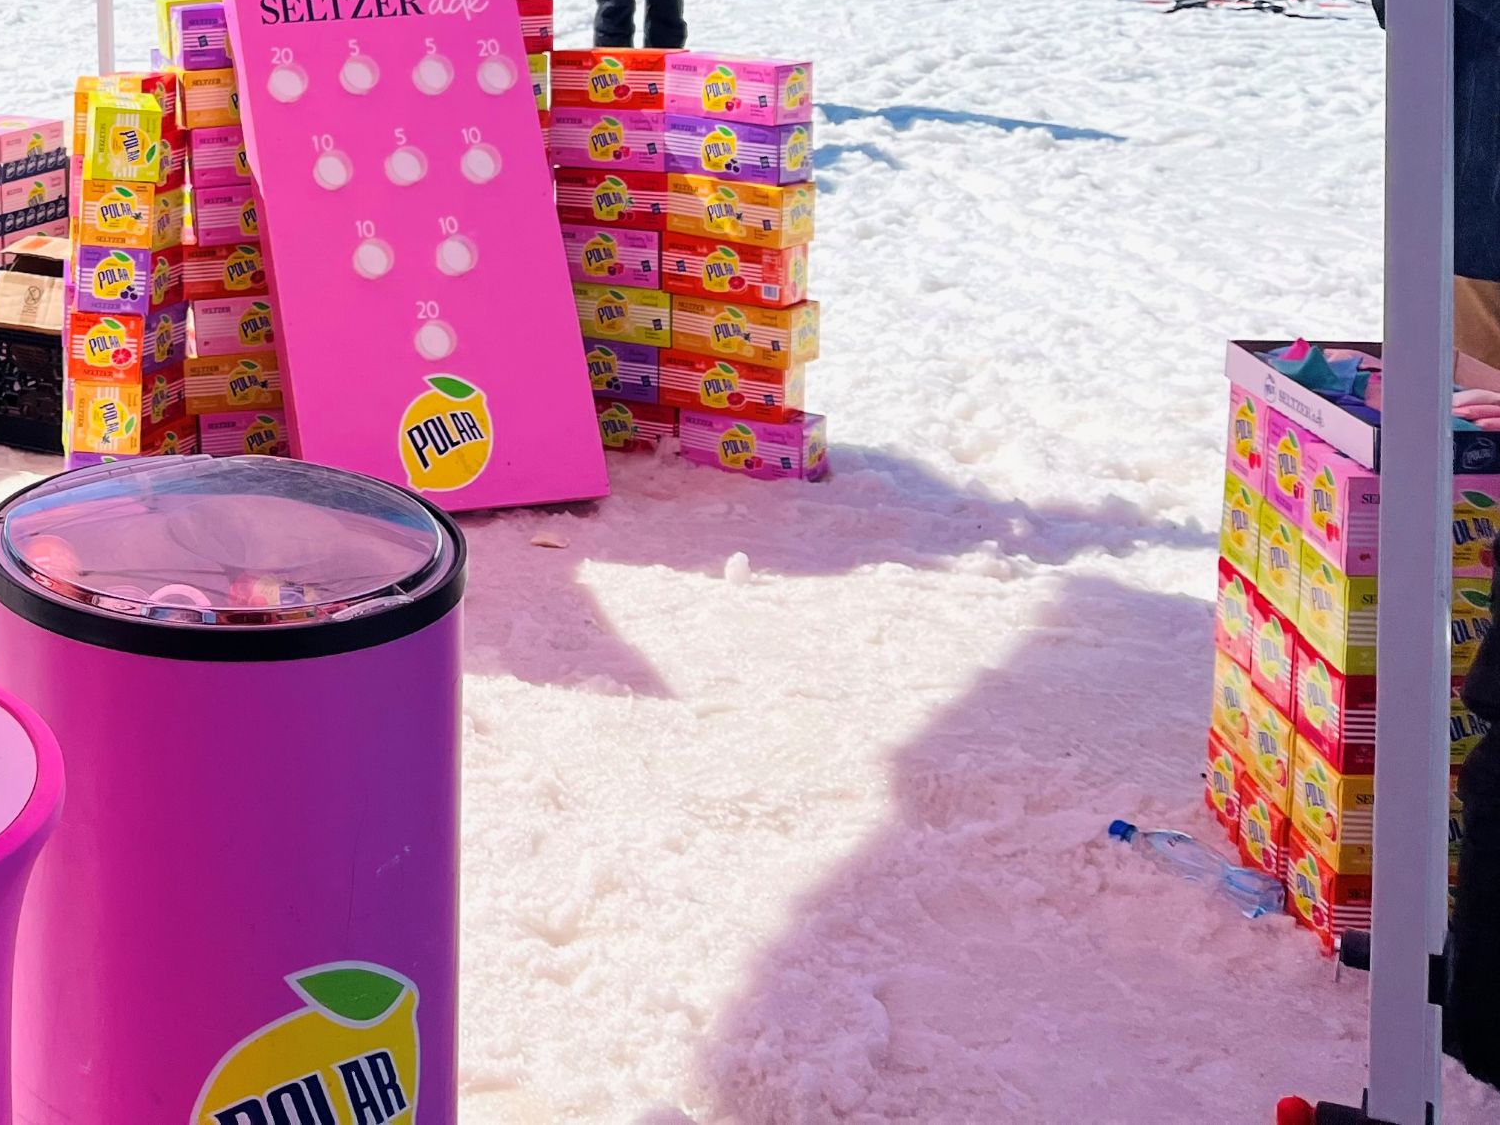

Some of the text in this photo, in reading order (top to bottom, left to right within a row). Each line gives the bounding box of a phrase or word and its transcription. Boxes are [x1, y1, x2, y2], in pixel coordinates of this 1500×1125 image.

[271, 38, 500, 64] 20 5 5 20
[591, 73, 621, 94] POLAR
[705, 82, 732, 102] POLAR
[119, 130, 141, 163] POLAR
[312, 126, 482, 152] 10 5 10
[591, 131, 620, 152] POLAR
[704, 143, 732, 162] POLAR
[100, 201, 133, 223] POLAR
[595, 192, 625, 212] POLAR
[707, 203, 736, 223] POLAR
[355, 216, 459, 238] 10 10
[585, 247, 614, 267] POLAR
[97, 269, 130, 290] POLAR
[227, 259, 258, 282] POLAR
[705, 262, 735, 282] POLAR
[415, 301, 440, 319] 20
[597, 305, 626, 325] POLAR
[240, 315, 271, 338] POLAR
[713, 323, 744, 343] POLAR
[88, 335, 121, 357] POLAR
[229, 374, 260, 397] POLAR
[704, 378, 734, 397] POLAR
[100, 403, 120, 435] POLAR
[601, 419, 630, 437] POLAR
[246, 429, 276, 452] POLAR
[406, 410, 485, 471] POLAR
[722, 439, 752, 458] POLAR
